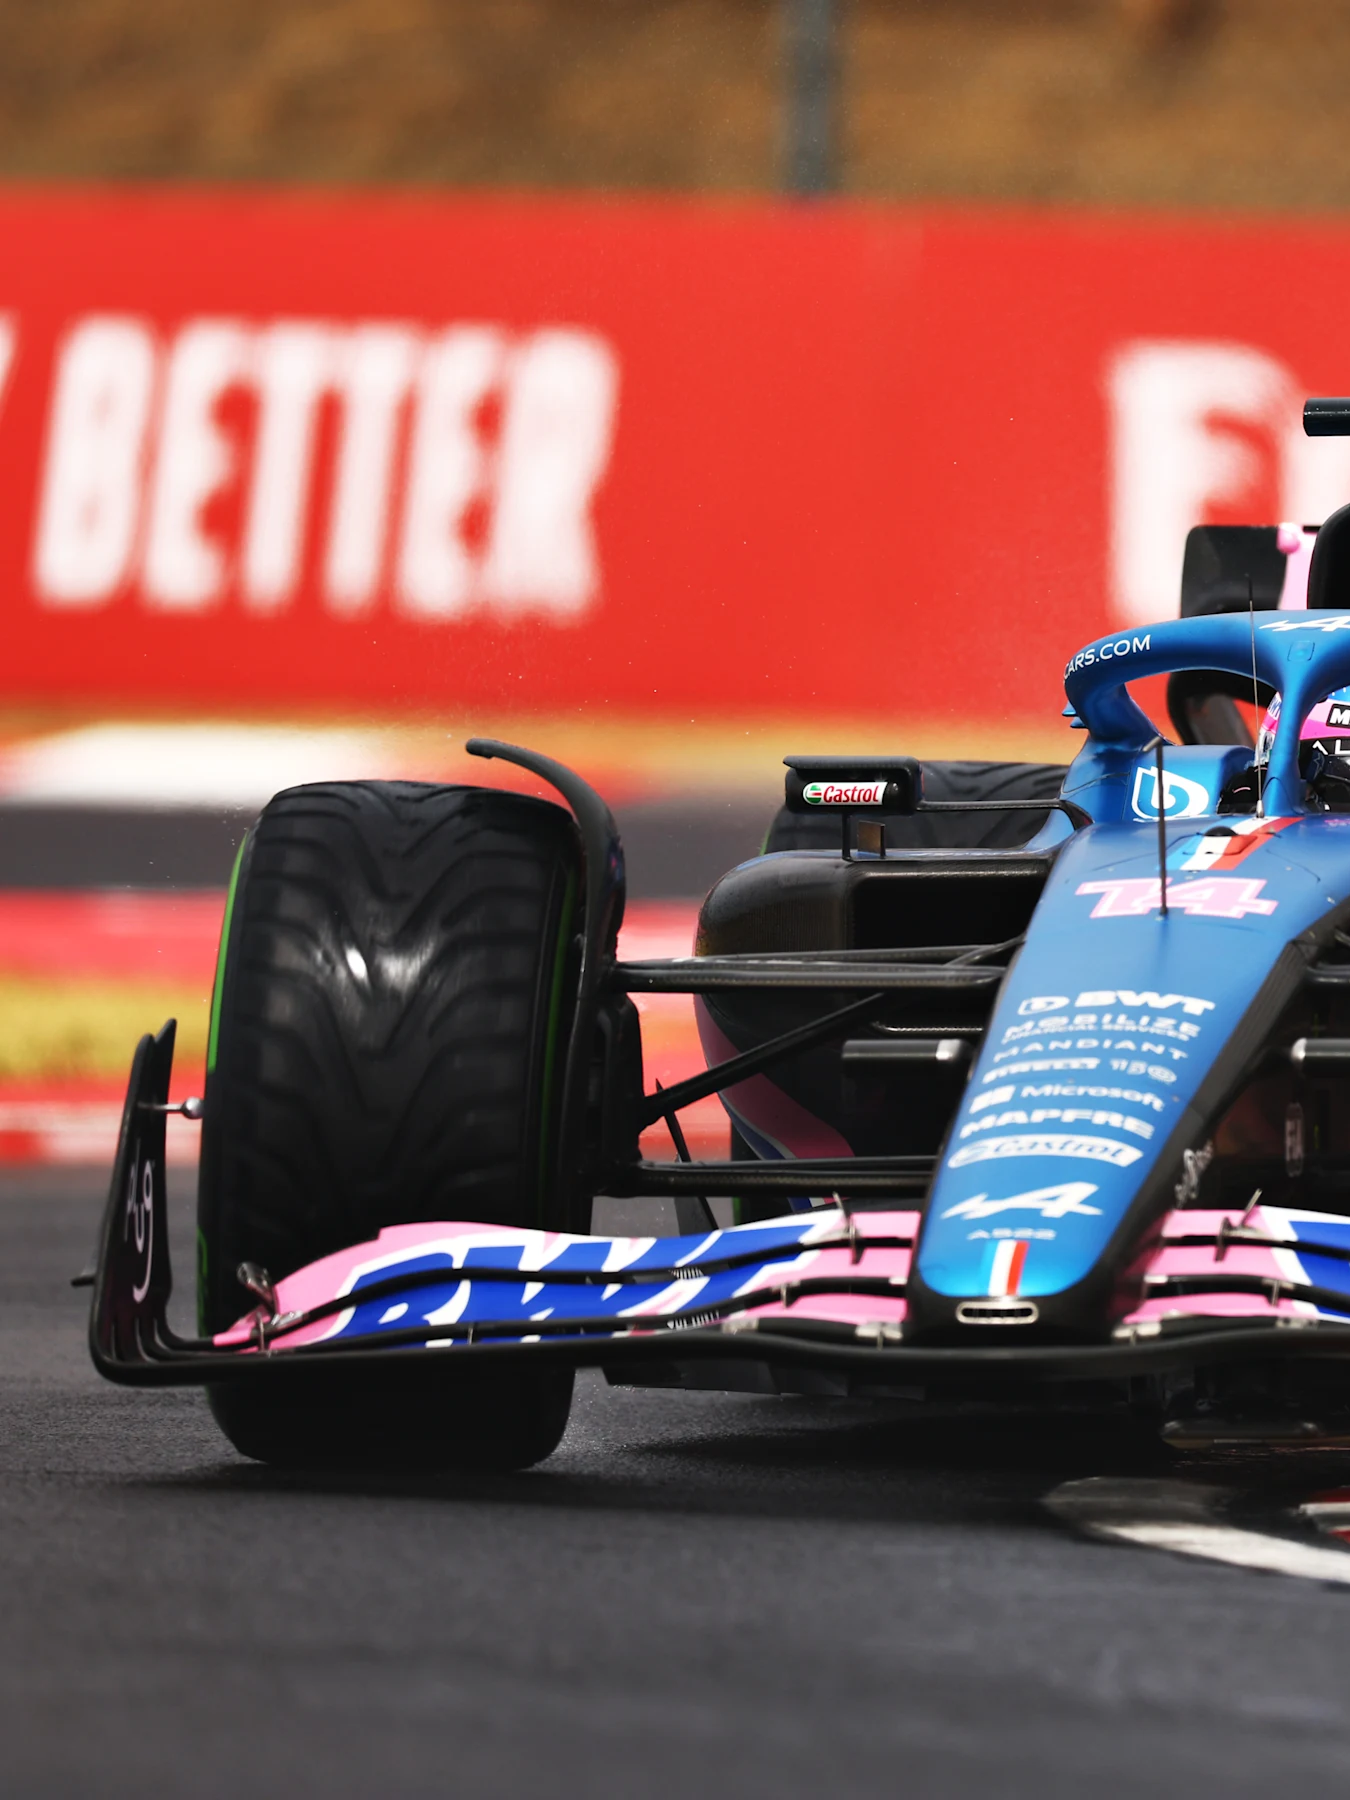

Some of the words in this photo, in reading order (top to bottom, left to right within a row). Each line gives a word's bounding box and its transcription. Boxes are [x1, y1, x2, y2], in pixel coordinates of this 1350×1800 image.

[36, 315, 618, 622] BETTER
[823, 785, 880, 803] Castrol
[1075, 876, 1279, 919] 14
[1074, 989, 1216, 1016] BWT
[1003, 1013, 1201, 1038] MOBILIZE
[993, 1038, 1189, 1063] MANDIANT
[1020, 1084, 1165, 1112] Microsoft
[959, 1108, 1156, 1140] MAPFRE
[994, 1139, 1124, 1158] Castrol
[304, 1212, 830, 1348] BWT
